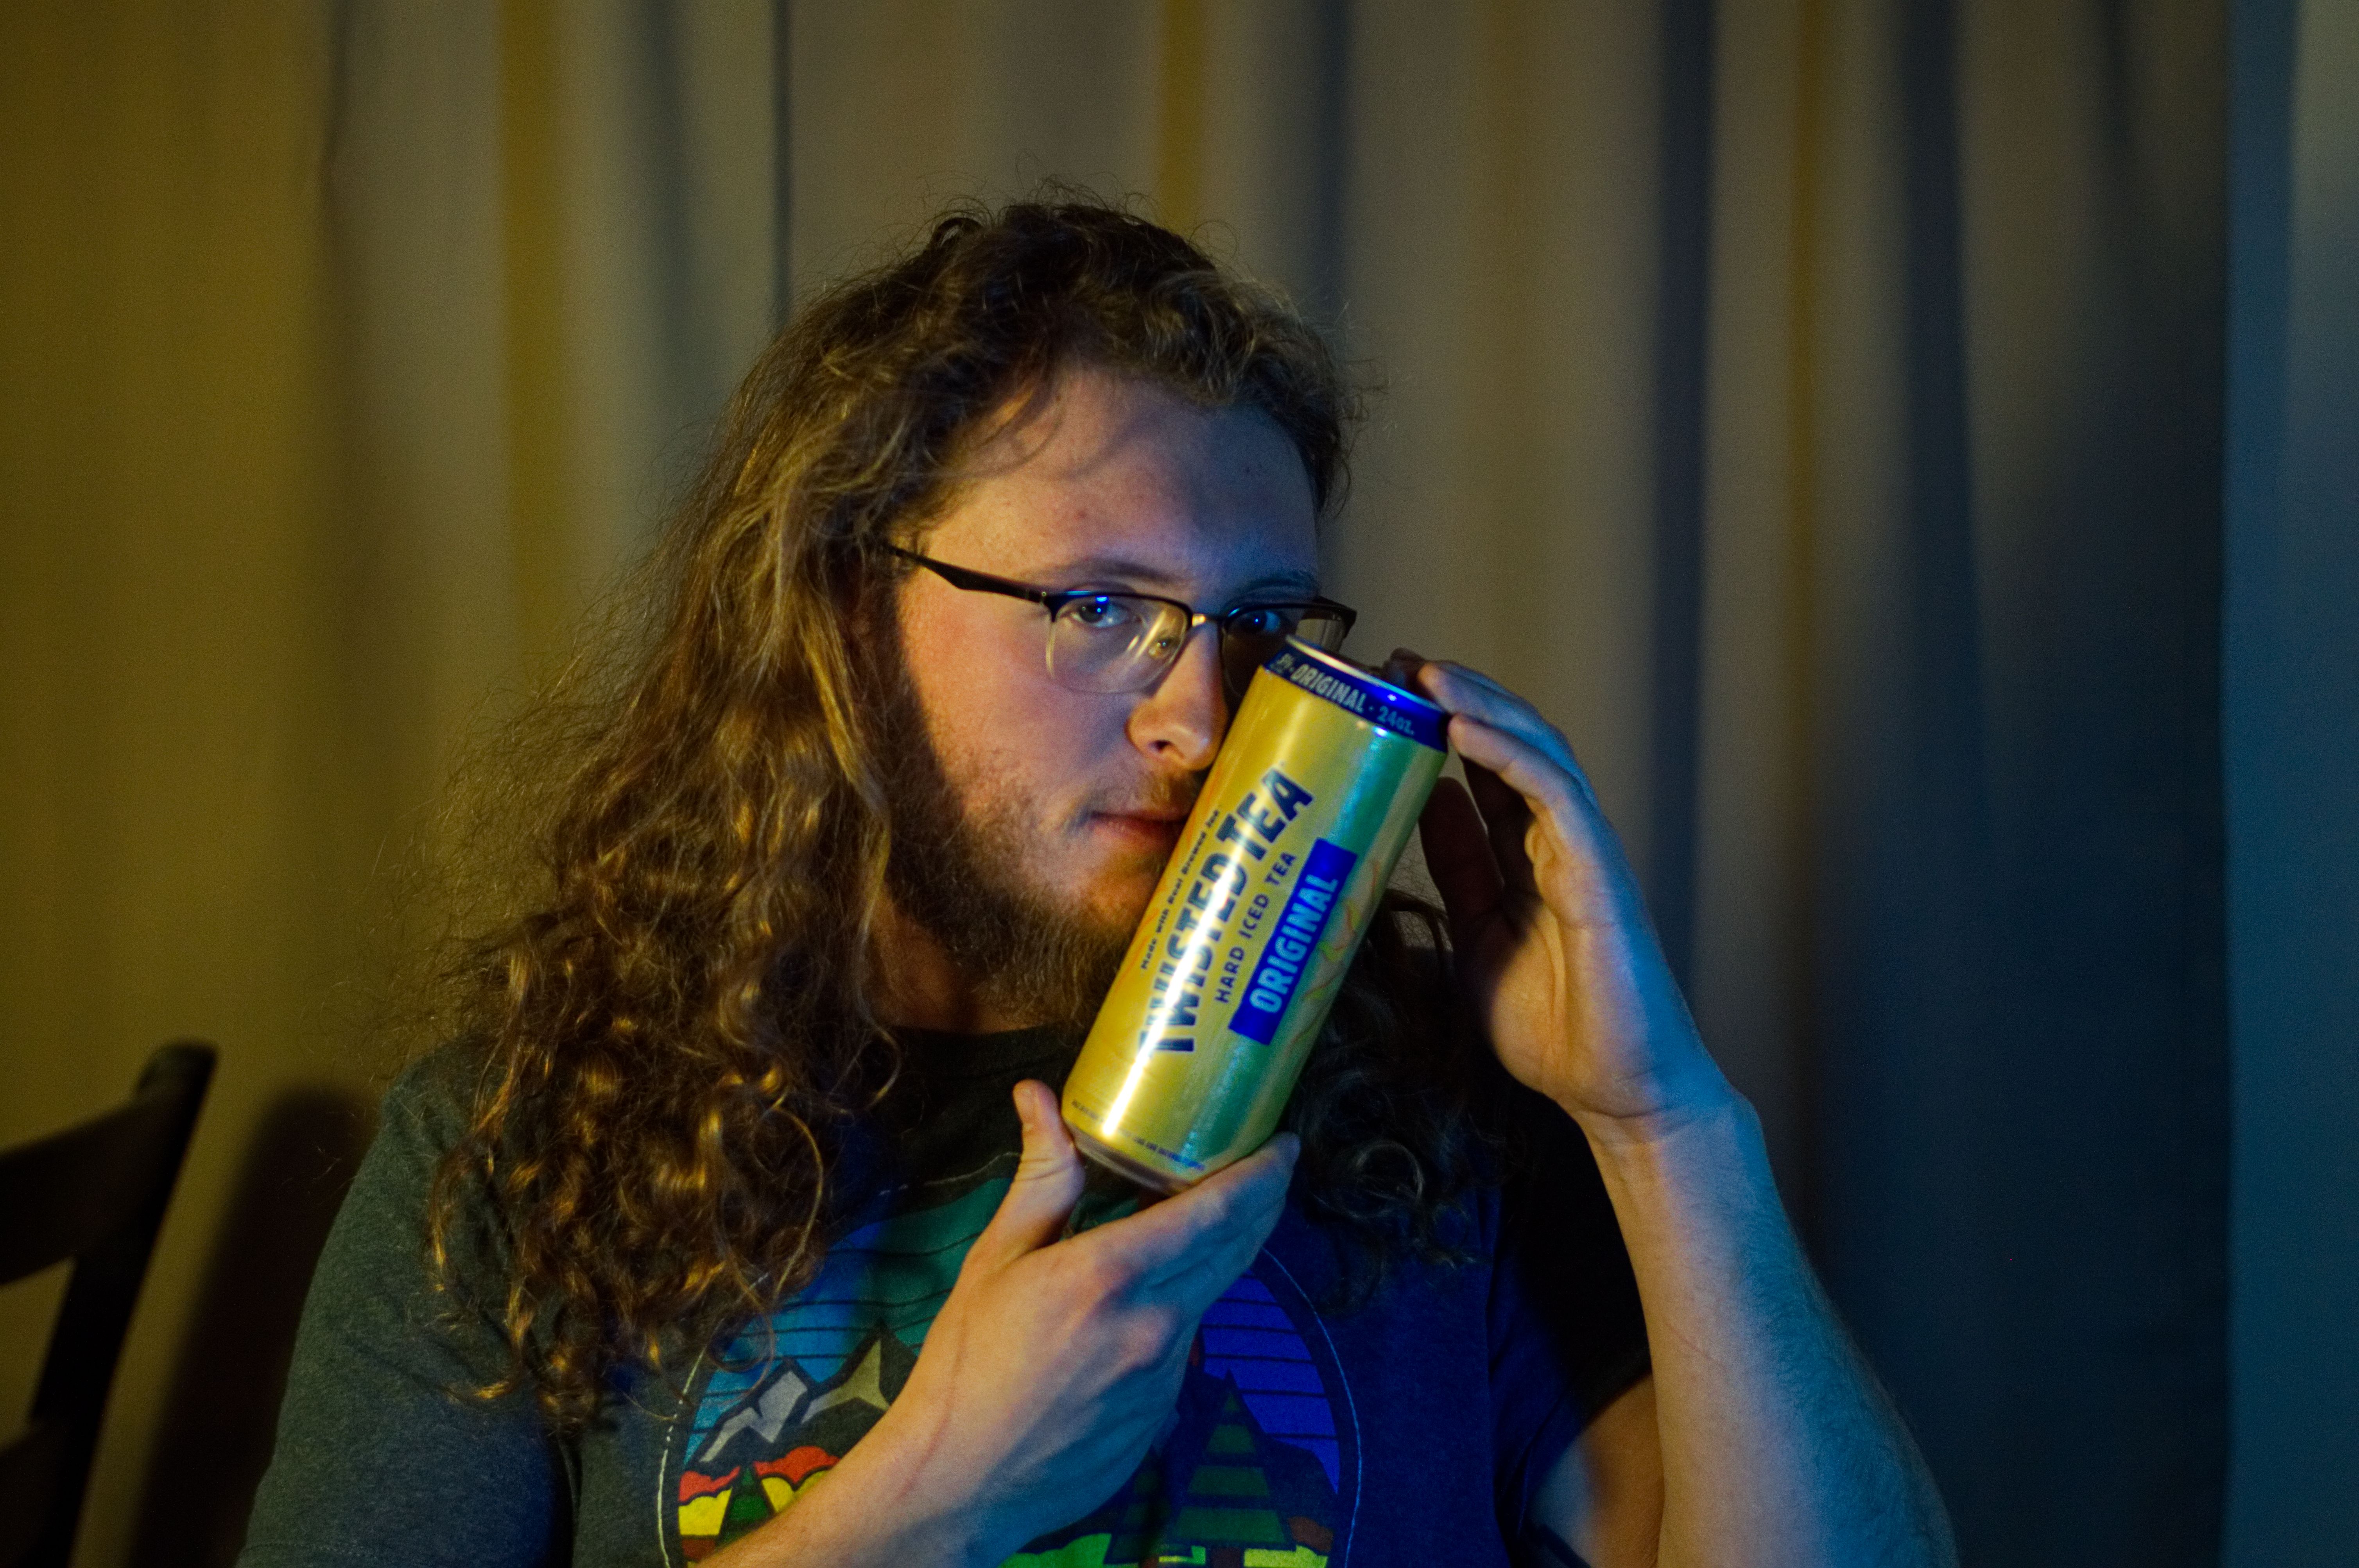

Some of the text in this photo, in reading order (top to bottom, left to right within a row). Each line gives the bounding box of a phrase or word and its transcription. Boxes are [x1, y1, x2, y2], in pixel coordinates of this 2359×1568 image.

[1291, 664, 1366, 713] ORIGINAL
[1139, 768, 1314, 1057] TWISTED TEA
[1141, 938, 1156, 969] Made
[1156, 908, 1169, 933] with
[1167, 878, 1182, 904] Real
[1181, 832, 1206, 875] Brewed
[1215, 852, 1296, 1003] HARD ICED TEA
[1249, 874, 1339, 1013] ORIGINAL
